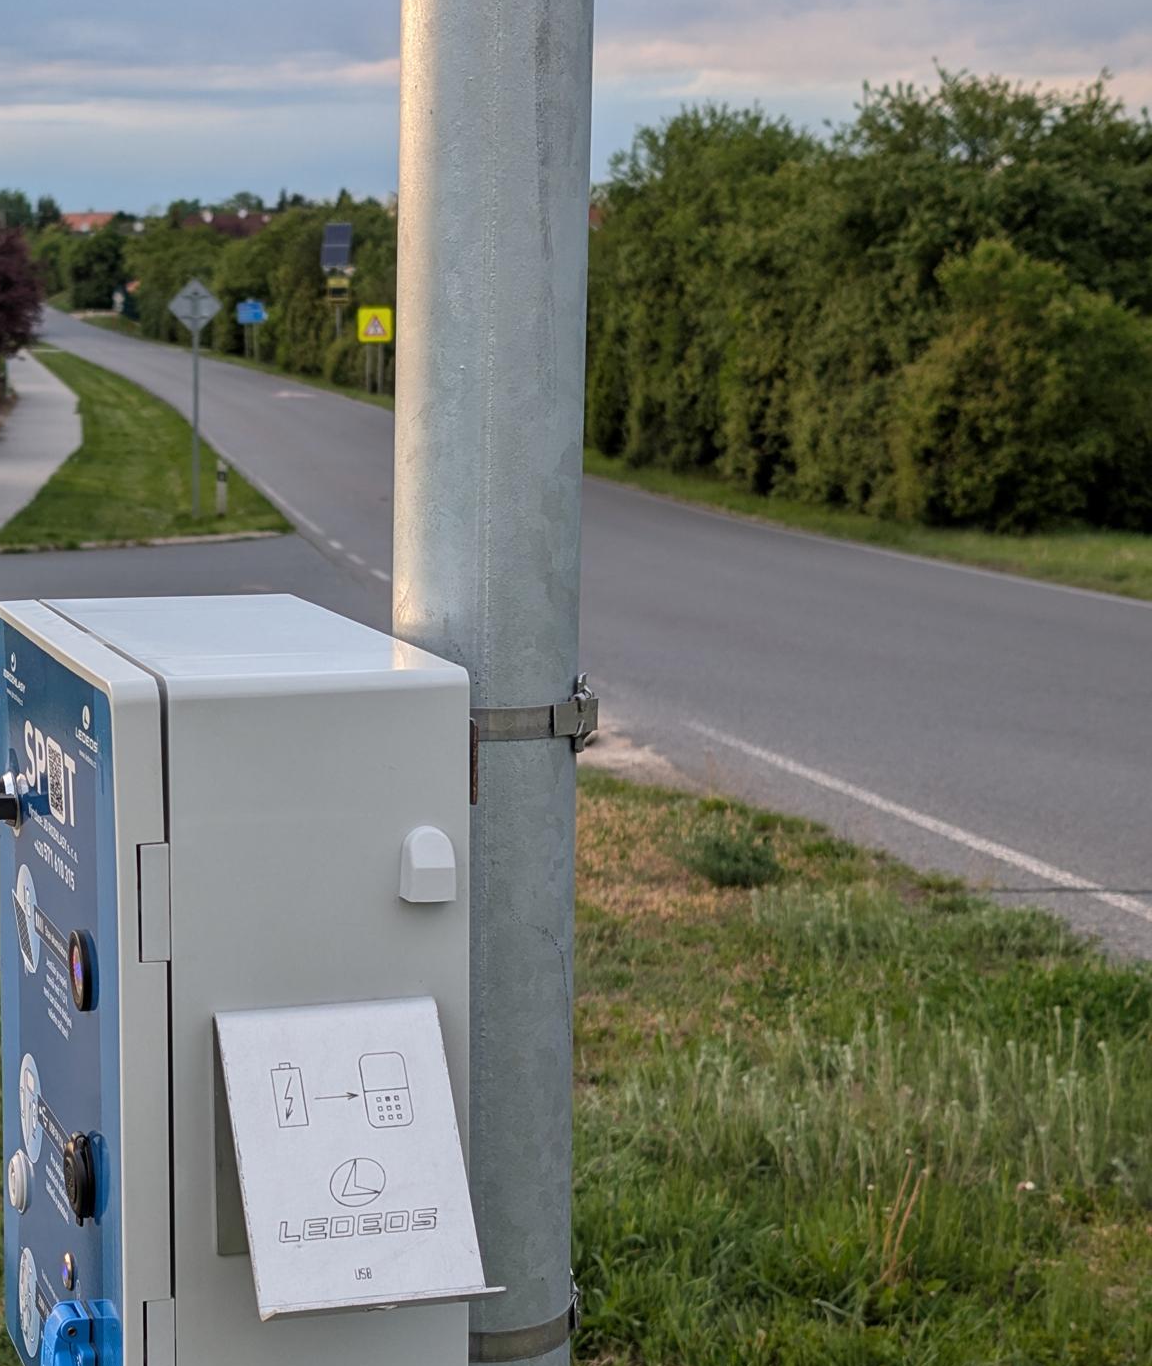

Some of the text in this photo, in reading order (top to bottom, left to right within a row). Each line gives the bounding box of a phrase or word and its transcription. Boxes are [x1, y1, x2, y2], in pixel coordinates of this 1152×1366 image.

[24, 720, 76, 827] SPOT
[279, 1208, 437, 1243] LEDEOS
[355, 1267, 373, 1280] USB
